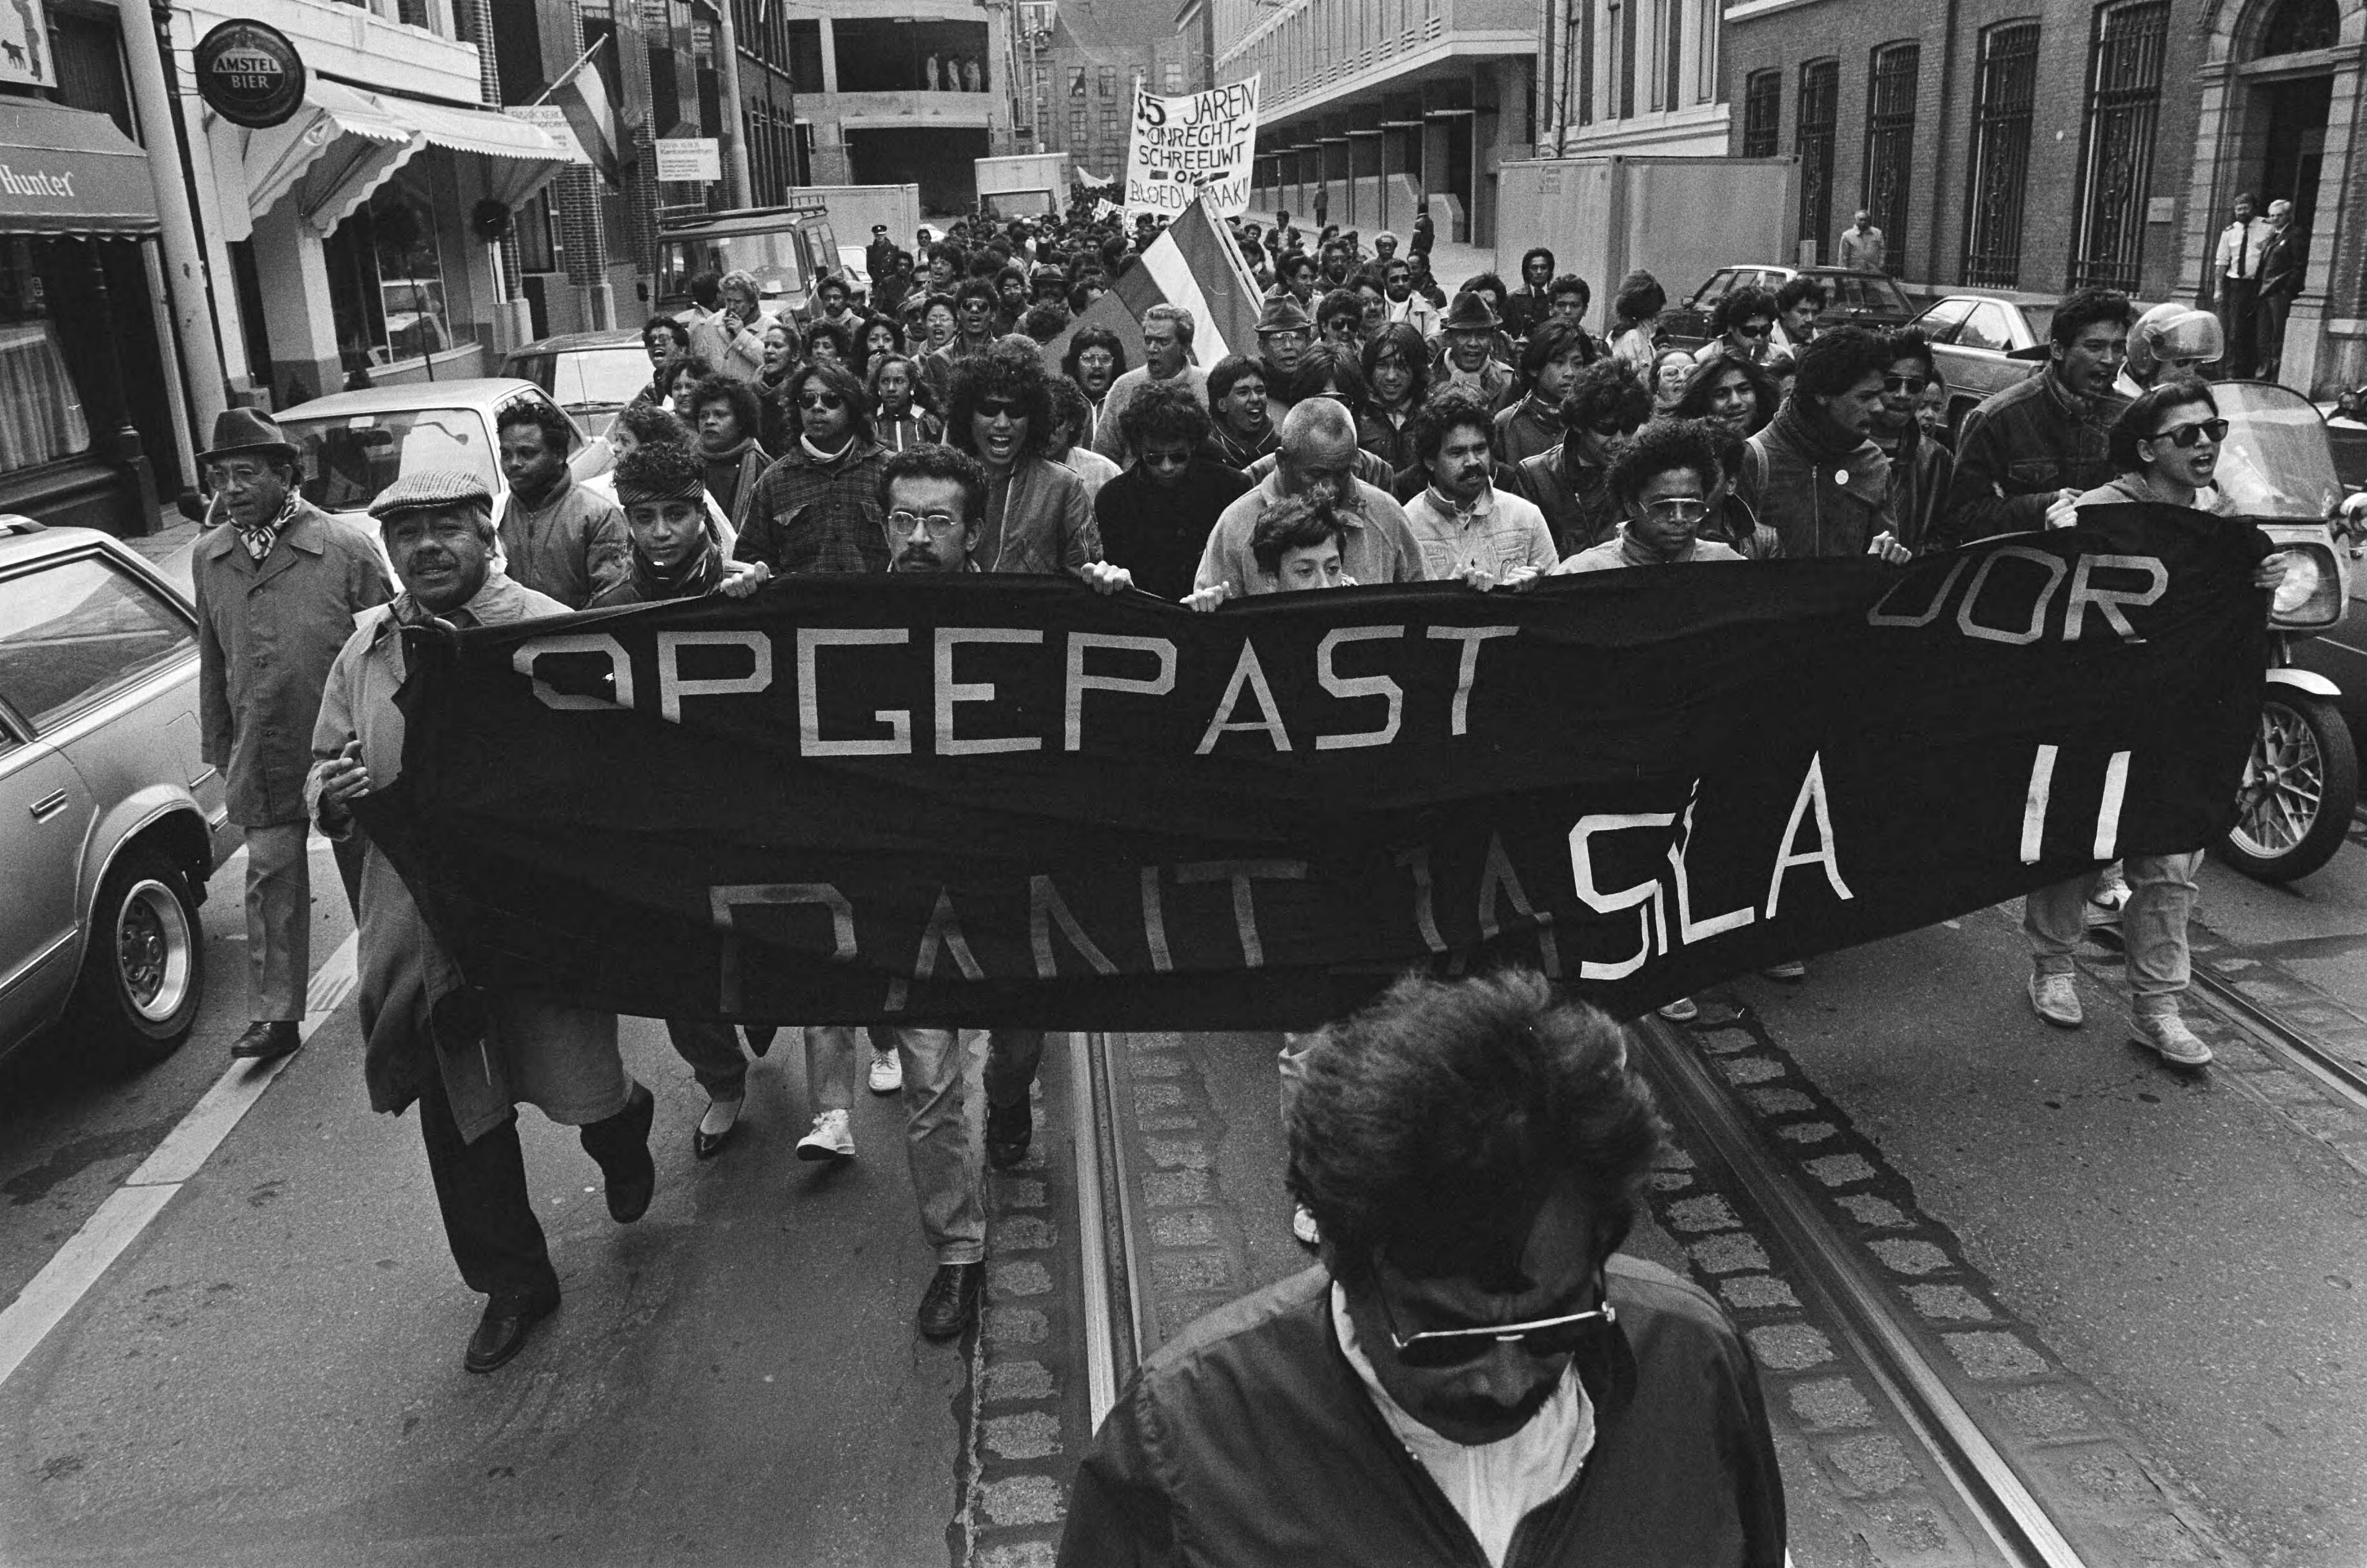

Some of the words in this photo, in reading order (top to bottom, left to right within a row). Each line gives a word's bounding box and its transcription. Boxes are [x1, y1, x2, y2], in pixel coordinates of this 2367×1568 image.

[216, 57, 277, 72] AMSTEL
[232, 75, 270, 88] BIER
[1184, 79, 1256, 125] JAREN
[1147, 118, 1236, 147] ONRECHT
[1139, 141, 1245, 169] SCHREEUWT
[0, 164, 75, 196] Hunter
[1174, 170, 1203, 184] OM
[513, 625, 1520, 757] OPGEPAST
